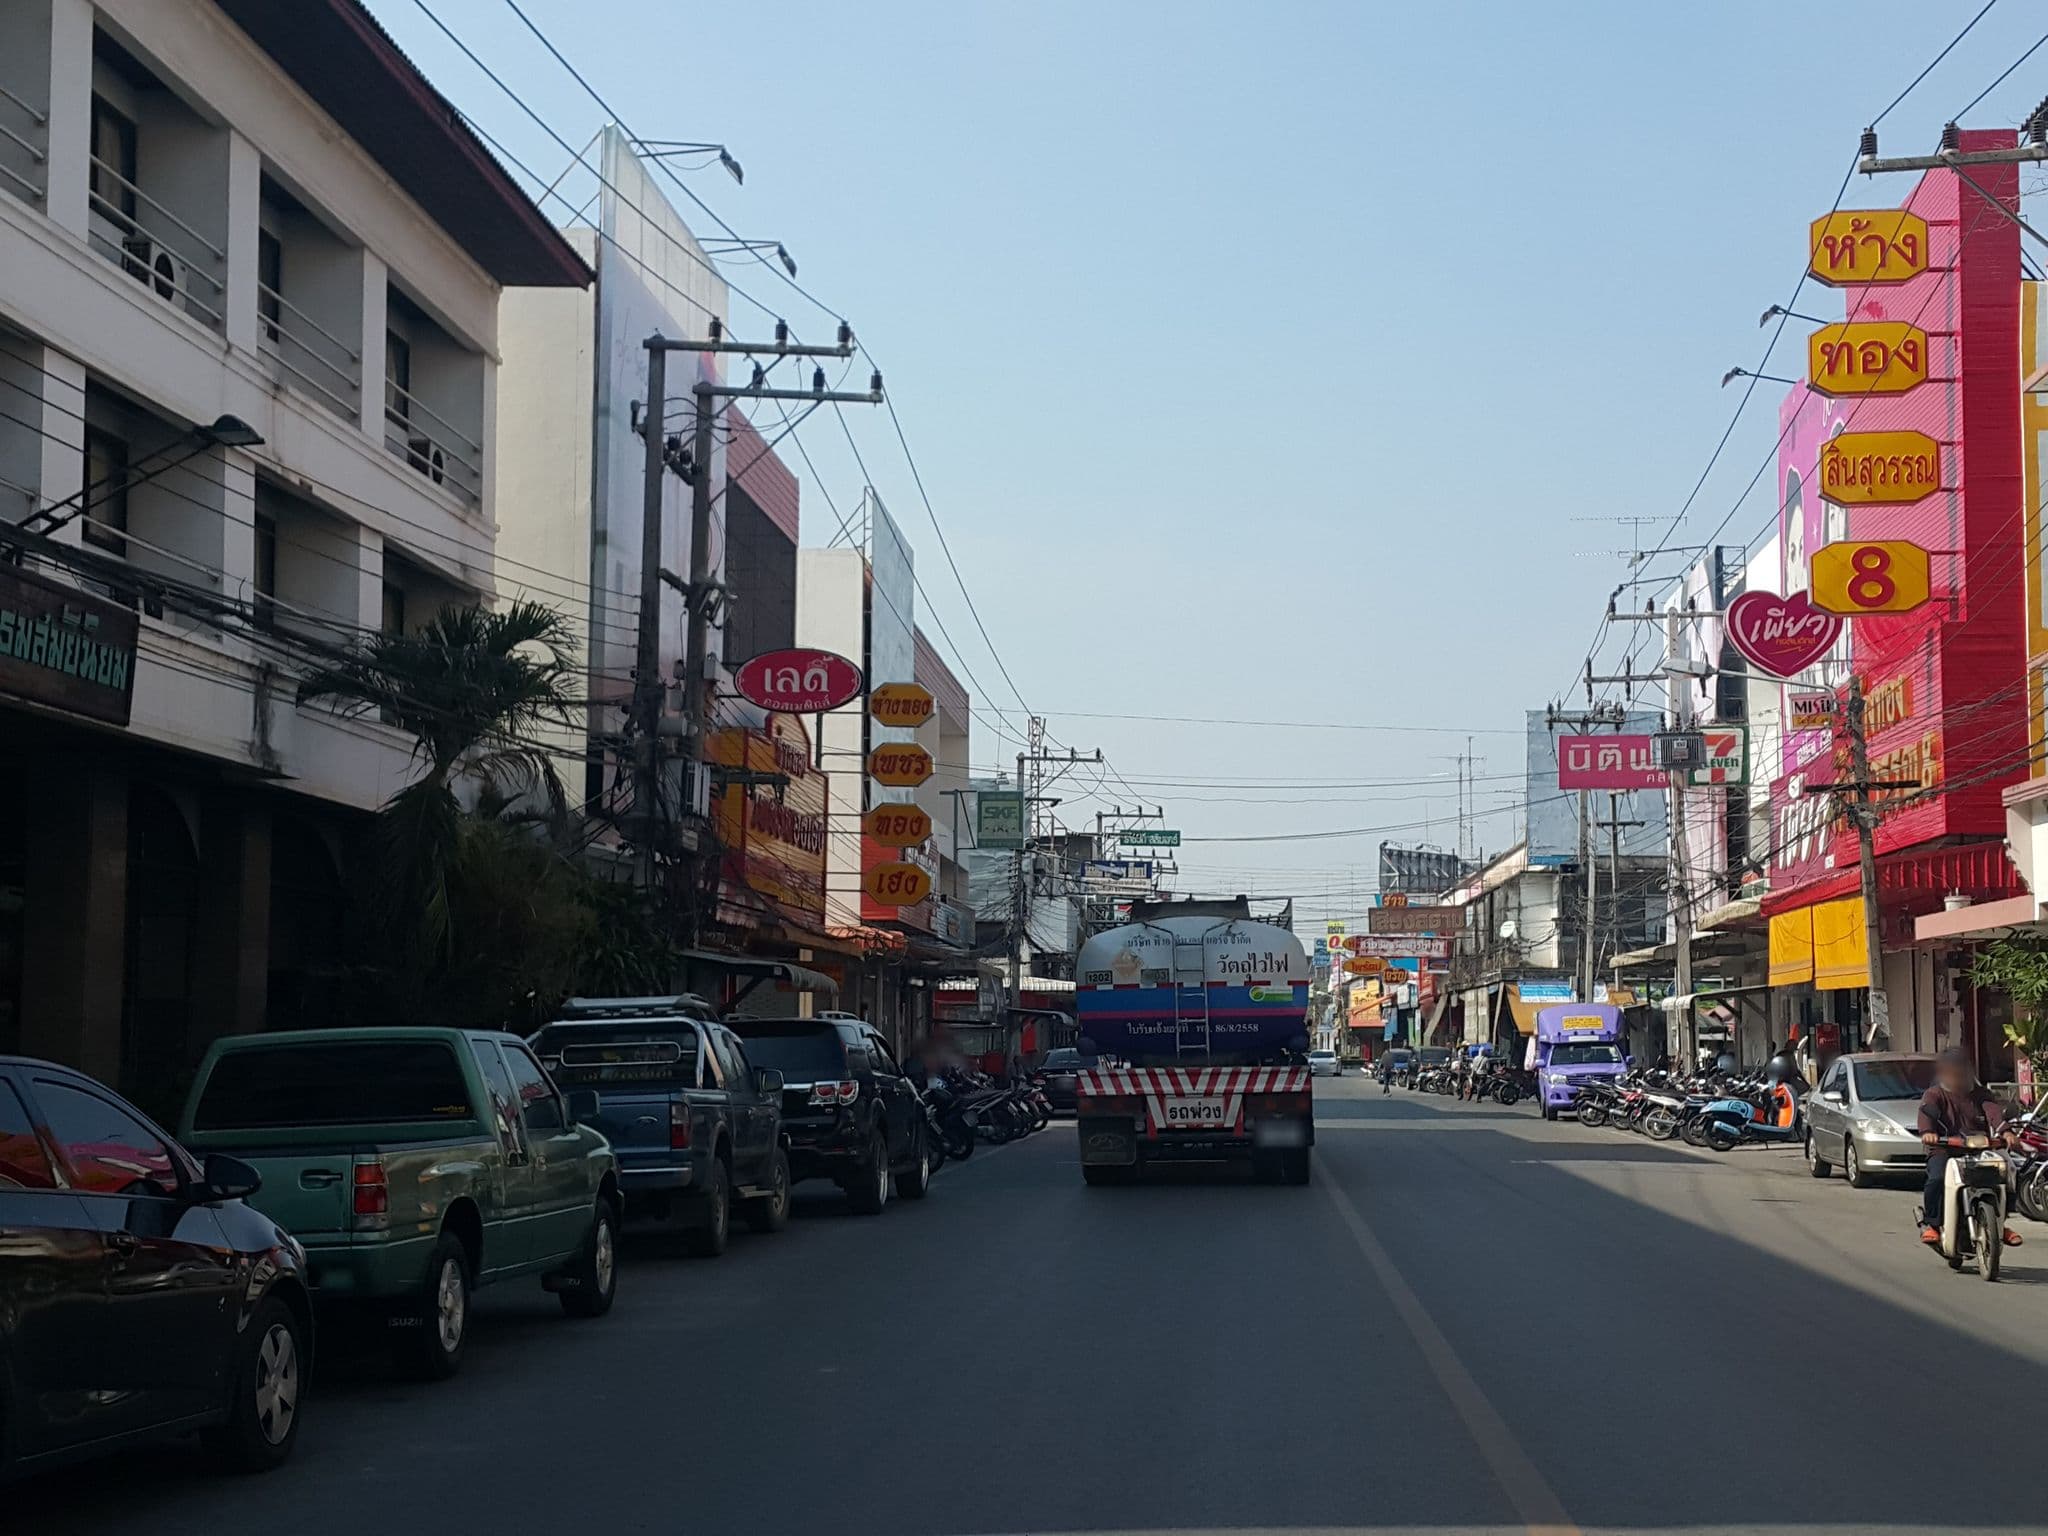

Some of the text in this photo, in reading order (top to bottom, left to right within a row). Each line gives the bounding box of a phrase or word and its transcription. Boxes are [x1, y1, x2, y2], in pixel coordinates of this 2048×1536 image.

[1822, 218, 1919, 270] ห้าง
[1820, 338, 1920, 377] ทอง
[1826, 444, 1937, 495] สินสุวรรณ
[1846, 546, 1896, 608] 8
[1750, 607, 1826, 643] เพียว
[764, 655, 834, 693] เลดี้
[1216, 952, 1289, 982] วัตถุไวไฟ
[1215, 1023, 1259, 1033] 86/8/2558
[1169, 1101, 1222, 1120] รถพ่วง
